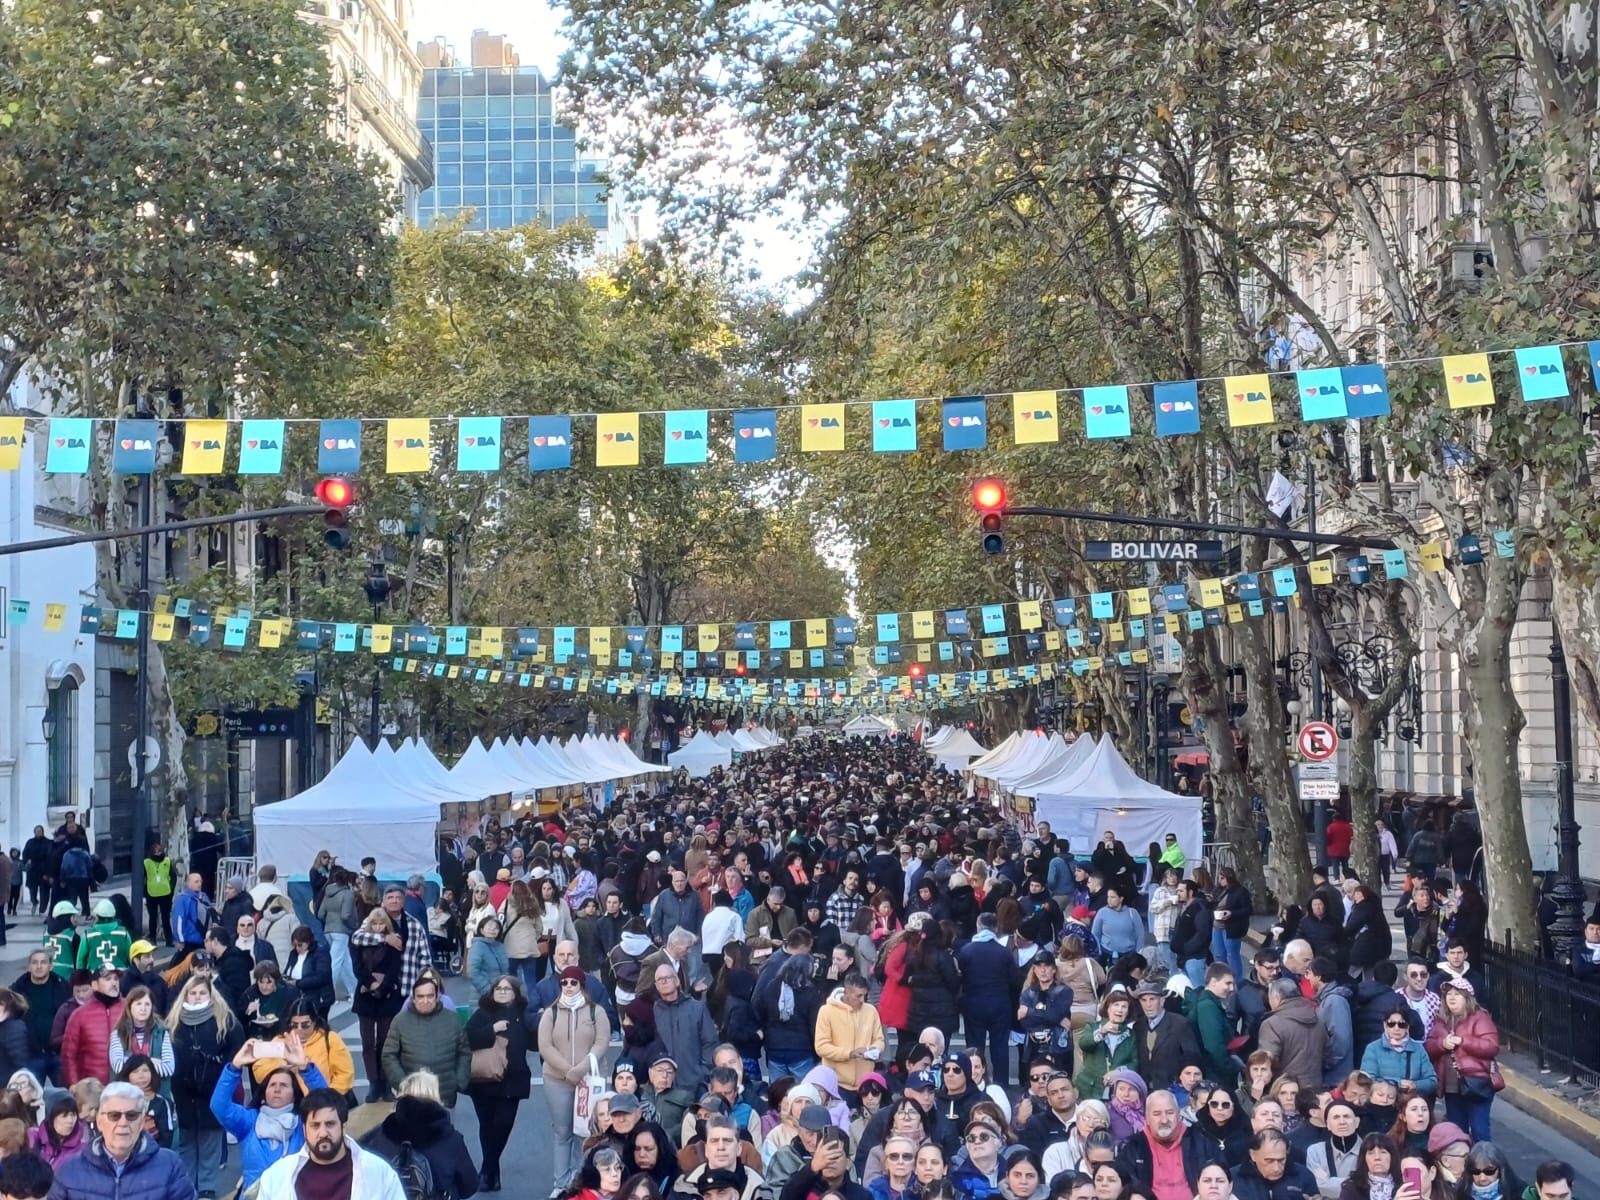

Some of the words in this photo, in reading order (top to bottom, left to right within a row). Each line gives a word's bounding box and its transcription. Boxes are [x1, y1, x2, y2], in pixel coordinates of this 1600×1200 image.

[1540, 363, 1560, 375] BA
[1466, 373, 1486, 383] BA
[1319, 385, 1339, 396] BA
[1363, 383, 1382, 395] BA
[1247, 392, 1267, 402] BA
[1105, 404, 1124, 415] BA
[1174, 400, 1194, 412] BA
[1034, 410, 1053, 420] BA
[821, 418, 839, 427] BA
[893, 418, 911, 427] BA
[962, 415, 981, 427] BA
[616, 432, 634, 442] BA
[684, 430, 703, 440] BA
[753, 427, 772, 439] BA
[0, 436, 17, 446] BA
[68, 438, 86, 449] BA
[134, 439, 152, 450] BA
[203, 440, 221, 450] BA
[260, 439, 278, 450] BA
[338, 438, 356, 450] BA
[406, 438, 424, 448] BA
[477, 436, 496, 446] BA
[547, 435, 566, 446] BA
[1111, 543, 1198, 559] BOLIVAR
[225, 718, 242, 726] Perú
